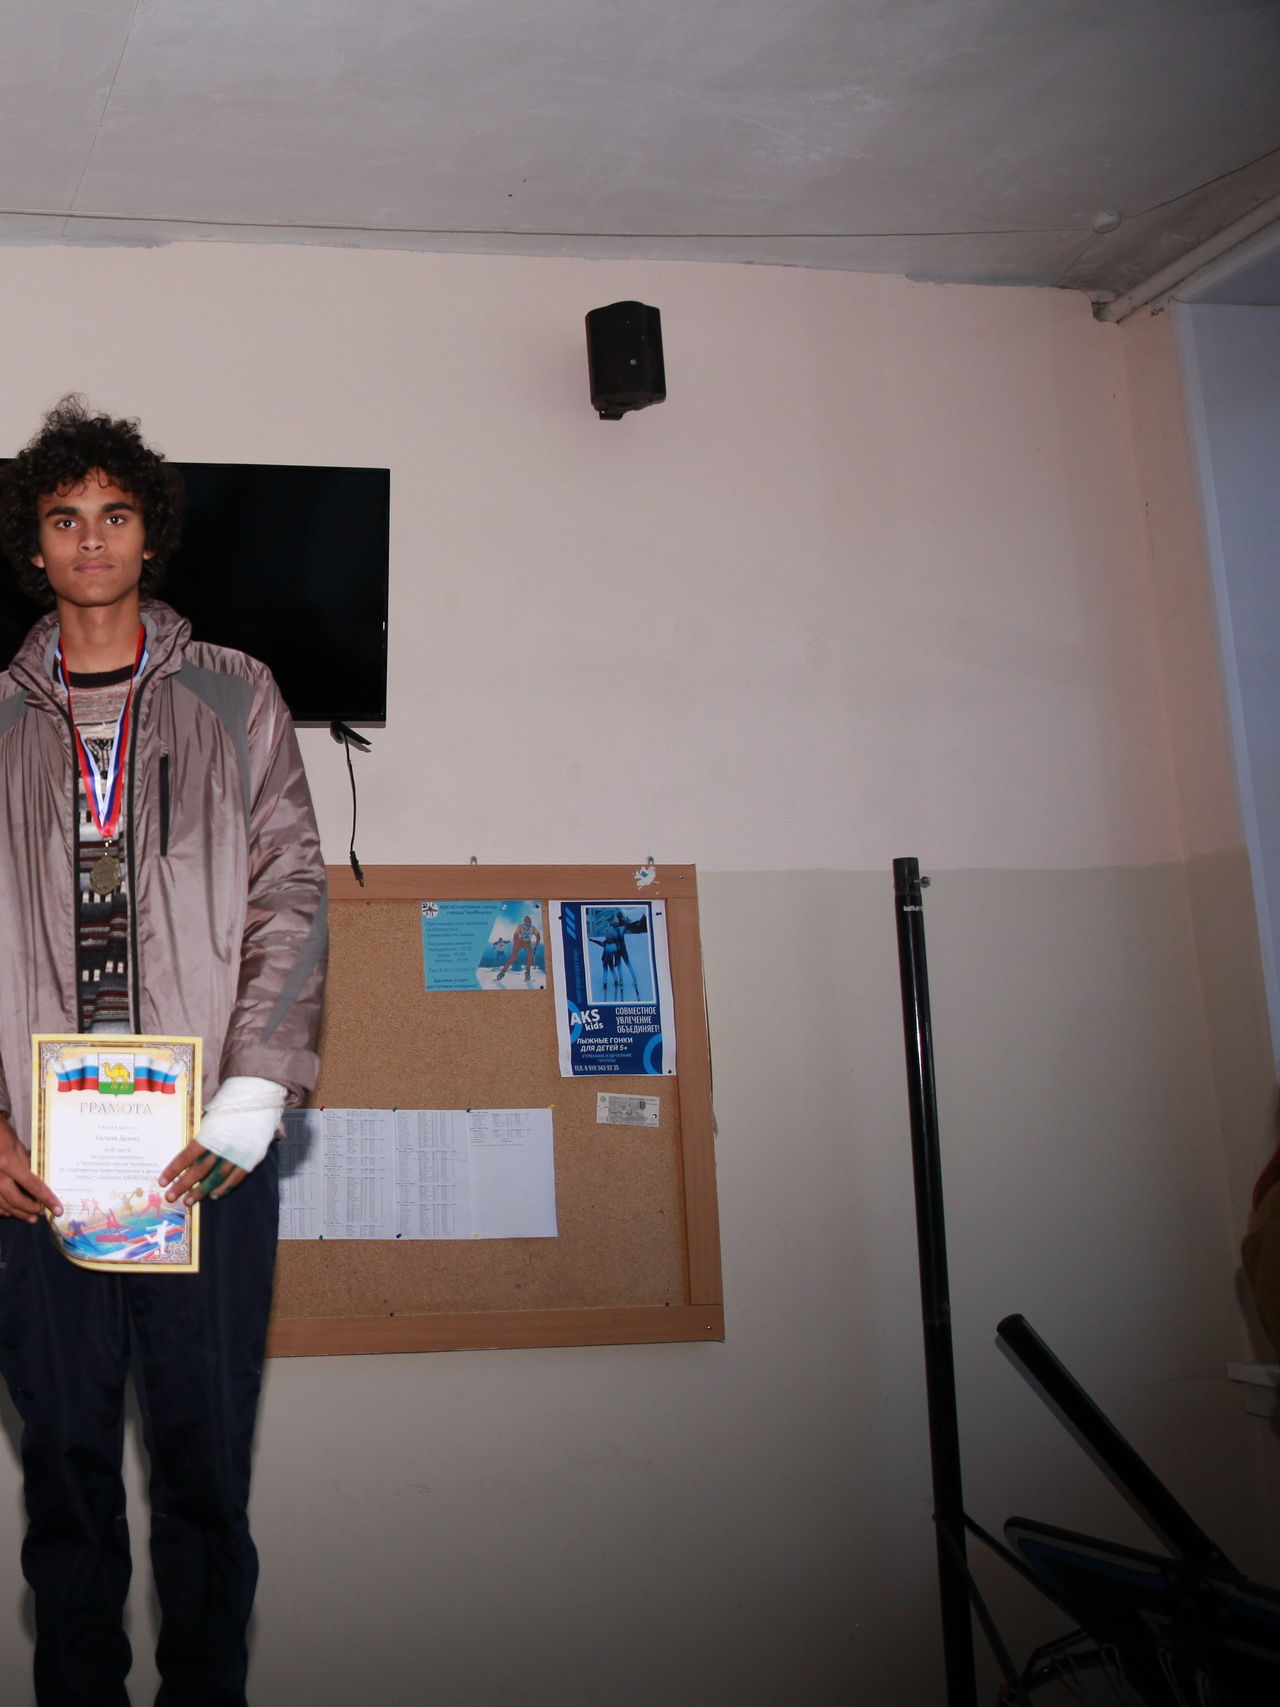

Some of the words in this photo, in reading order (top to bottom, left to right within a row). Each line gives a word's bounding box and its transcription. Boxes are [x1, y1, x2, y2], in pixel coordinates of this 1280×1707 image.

[615, 1006, 657, 1015] СОВМЕСТНОЕ
[570, 1008, 601, 1026] AKS
[615, 1016, 652, 1024] УВЛЕЧЕНИЕ
[585, 1022, 604, 1031] kids
[616, 1024, 660, 1034] ОБЪЕДИНЯЕТ!
[580, 1045, 595, 1053] ДЛЯ
[595, 1043, 618, 1052] ДЕТЕЙ
[79, 1101, 153, 1115] ГРАМОТА
